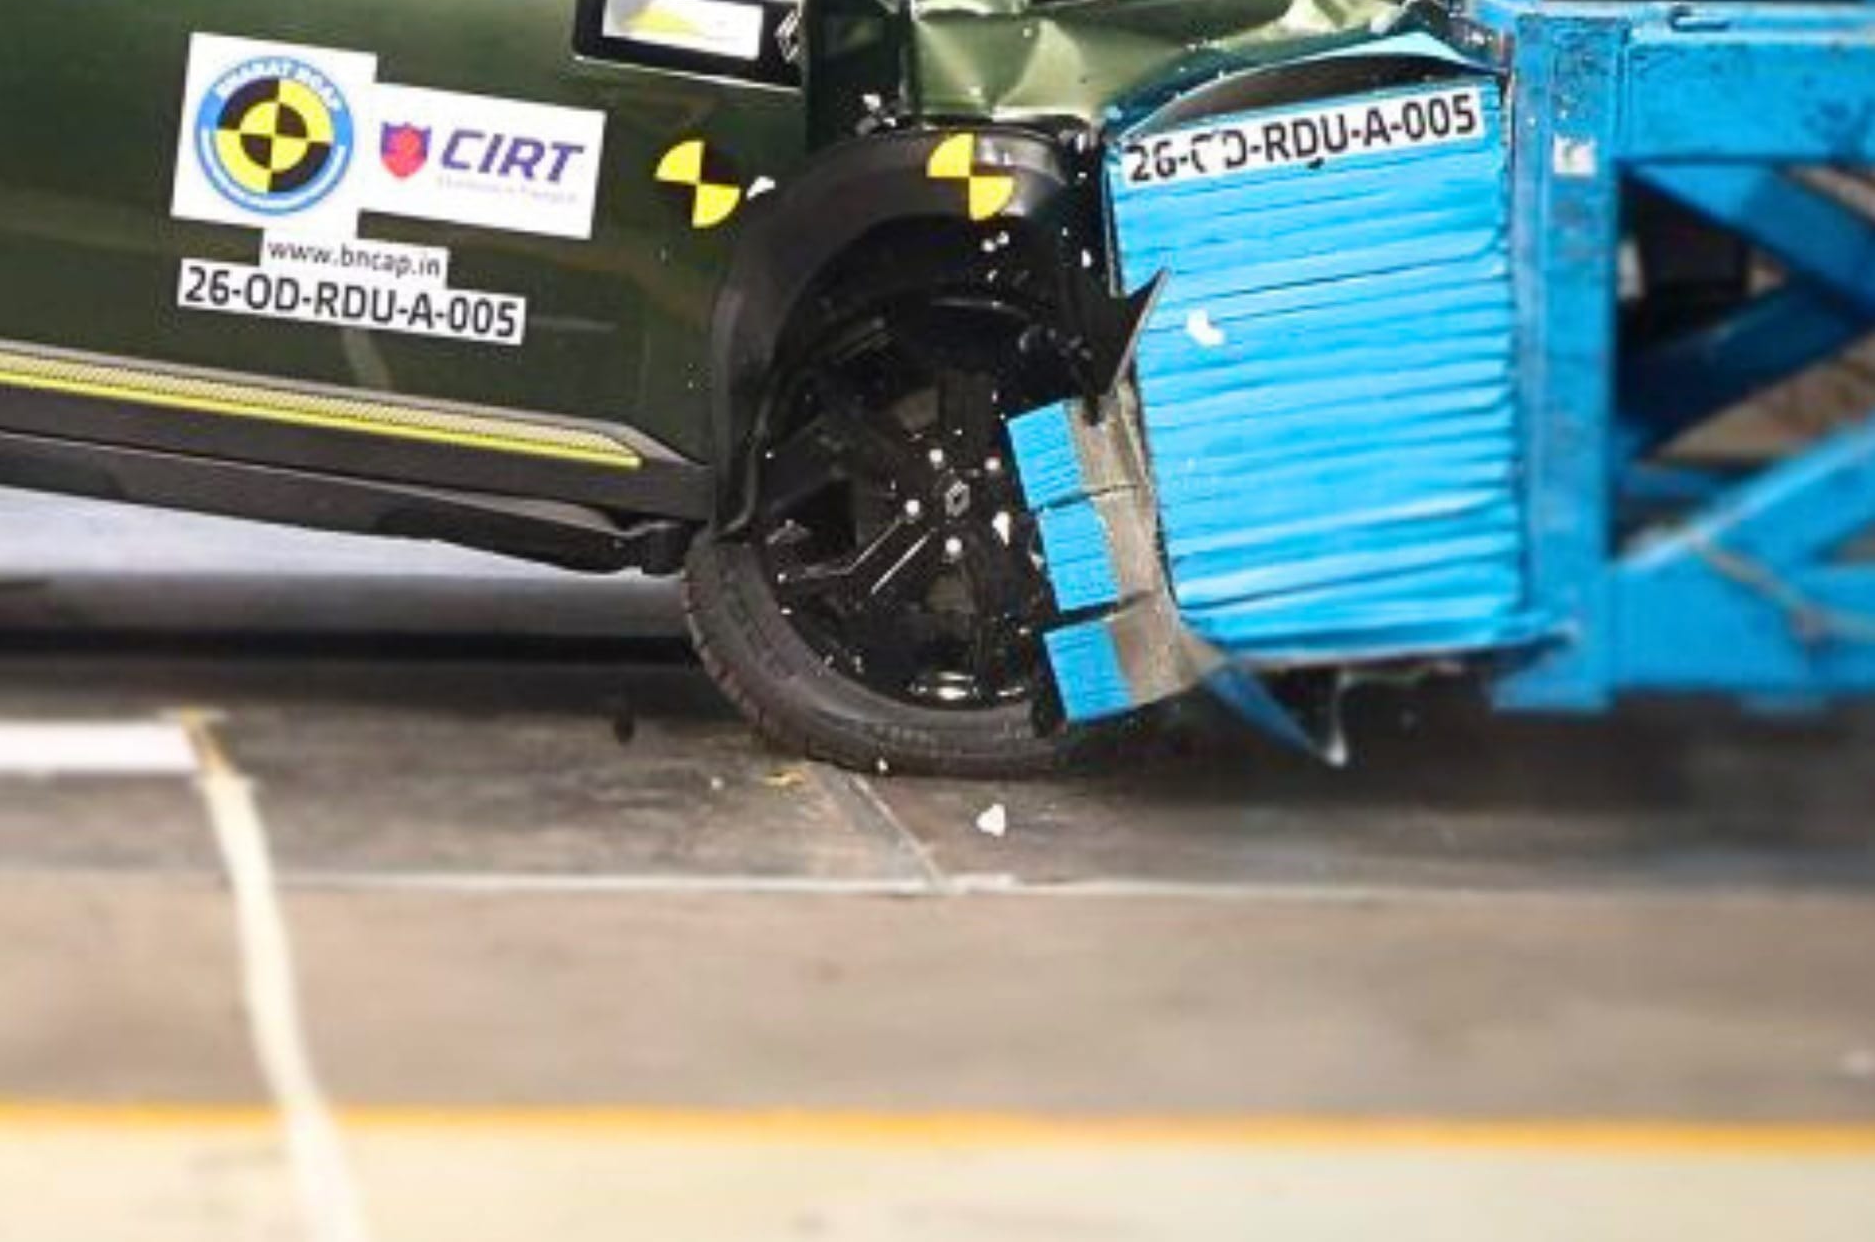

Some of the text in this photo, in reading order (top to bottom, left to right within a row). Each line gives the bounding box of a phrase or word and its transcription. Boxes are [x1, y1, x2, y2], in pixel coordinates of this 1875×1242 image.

[441, 128, 586, 183] CIRT
[267, 243, 440, 279] www.bncap.in
[184, 266, 518, 338] 26-OD-RDU-A-005
